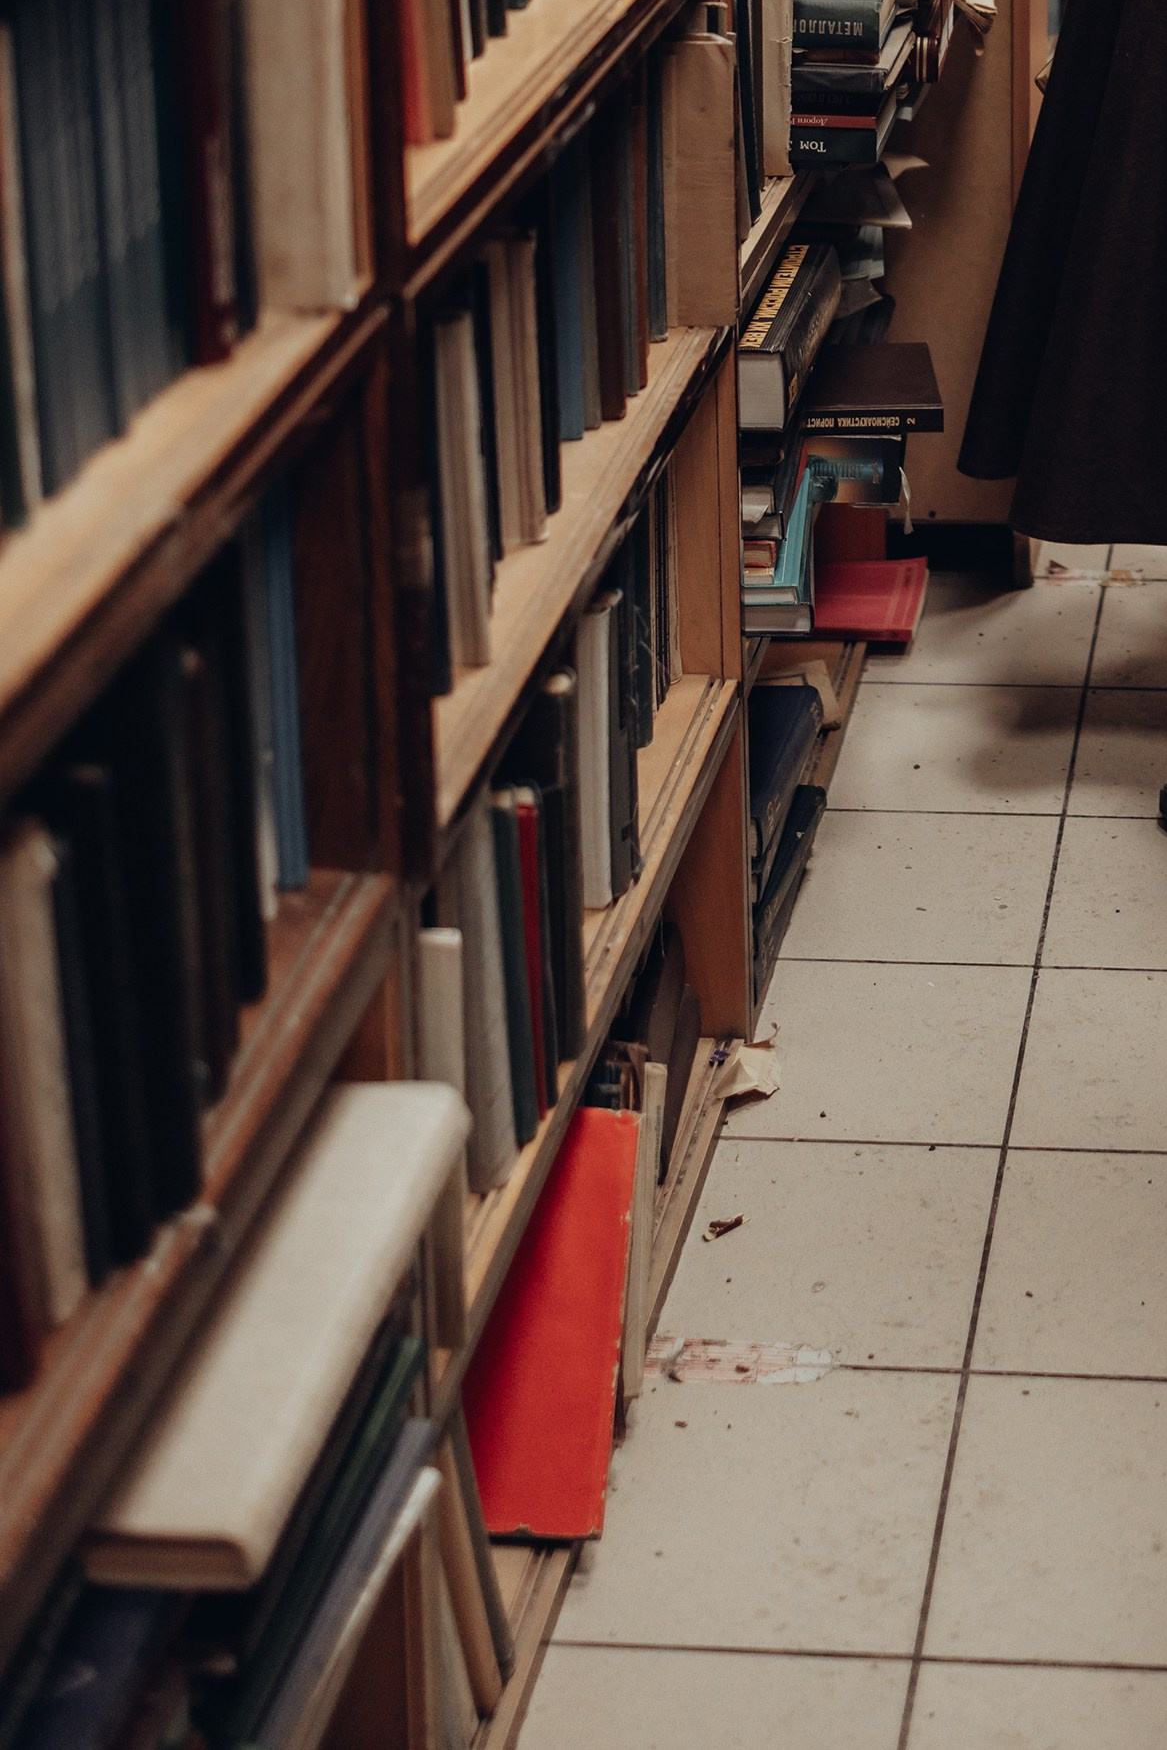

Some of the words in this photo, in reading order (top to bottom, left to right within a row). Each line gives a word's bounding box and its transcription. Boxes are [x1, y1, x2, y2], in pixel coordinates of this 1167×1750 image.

[797, 116, 829, 126] Дороги
[800, 140, 827, 153] Том
[837, 416, 900, 429] СЕЙСМОАКУСТИКА
[906, 417, 916, 425] 2
